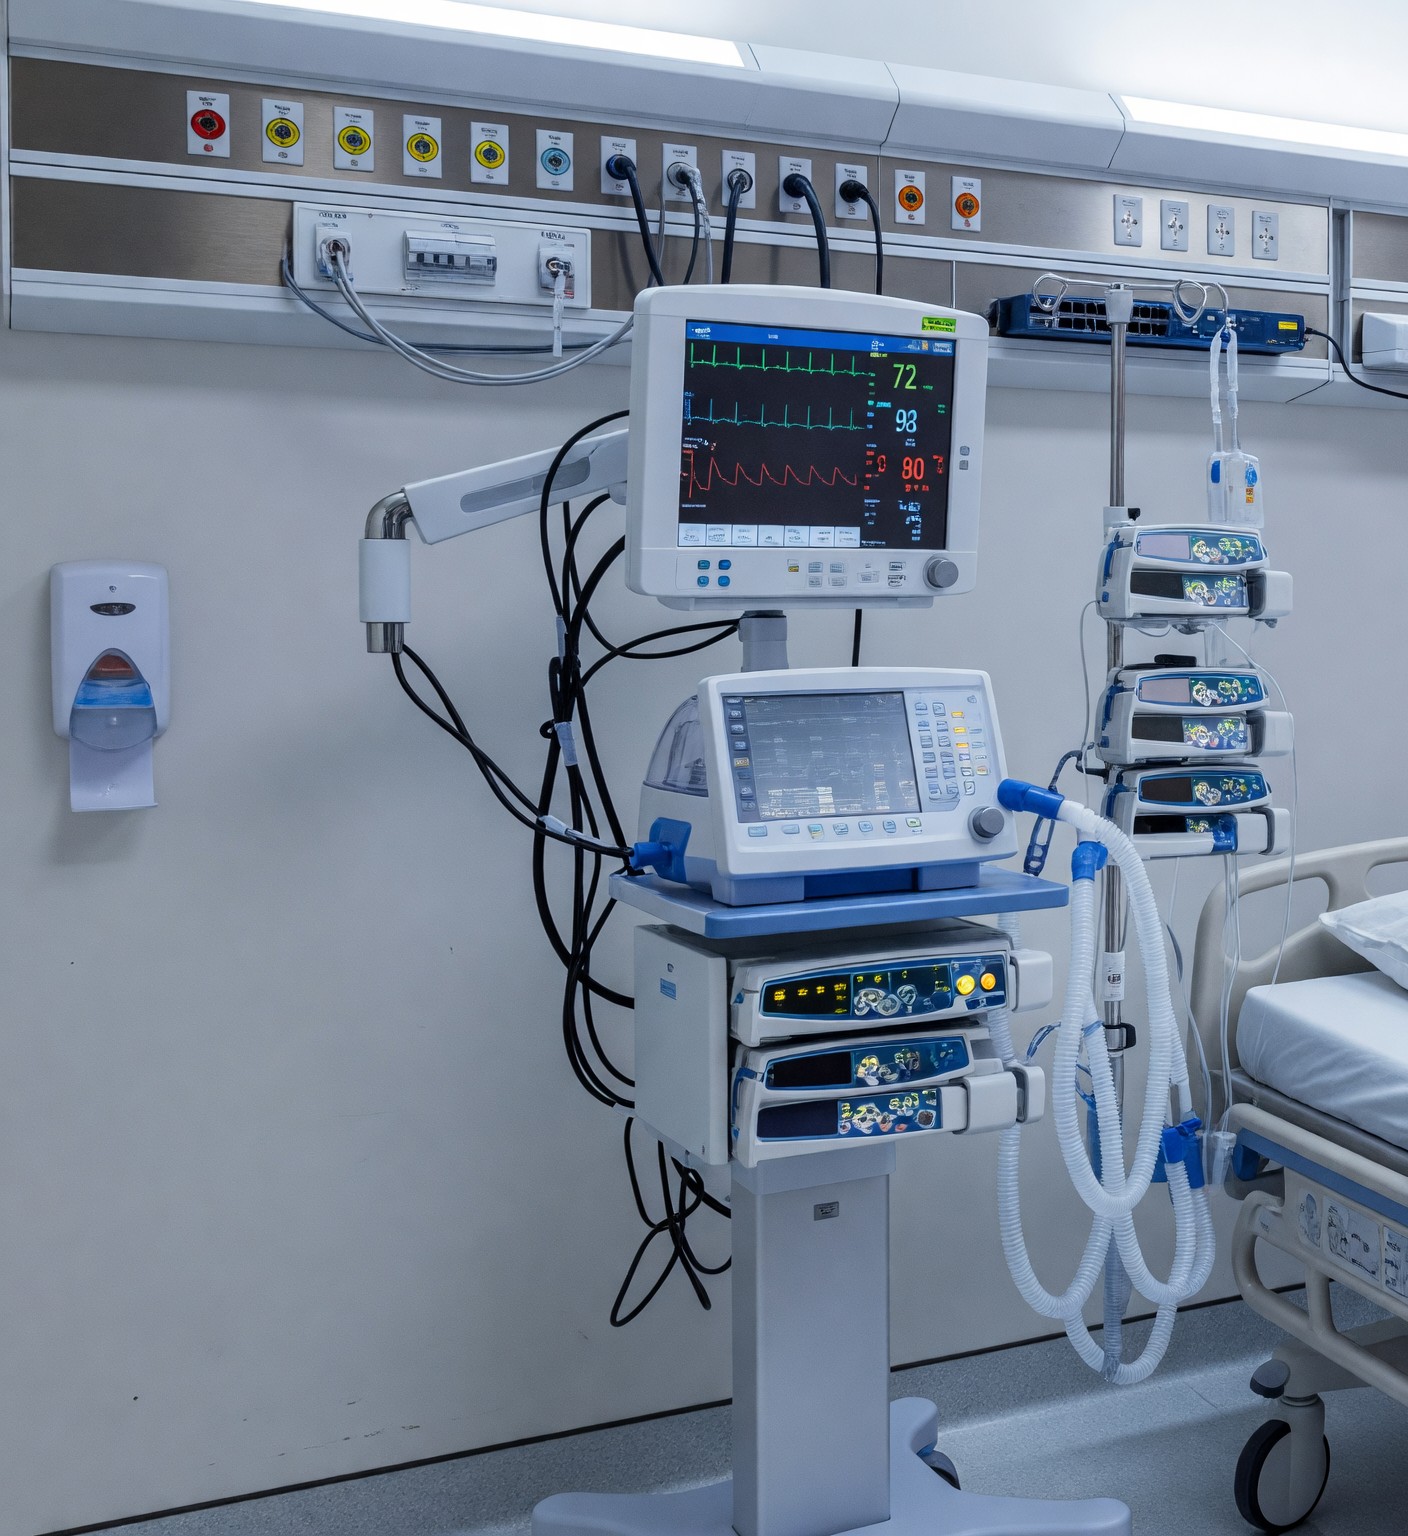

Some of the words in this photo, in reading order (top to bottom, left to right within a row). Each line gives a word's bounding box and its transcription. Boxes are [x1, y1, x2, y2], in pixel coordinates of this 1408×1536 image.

[893, 363, 917, 390] 72
[896, 409, 918, 433] 98
[902, 456, 925, 480] 80
